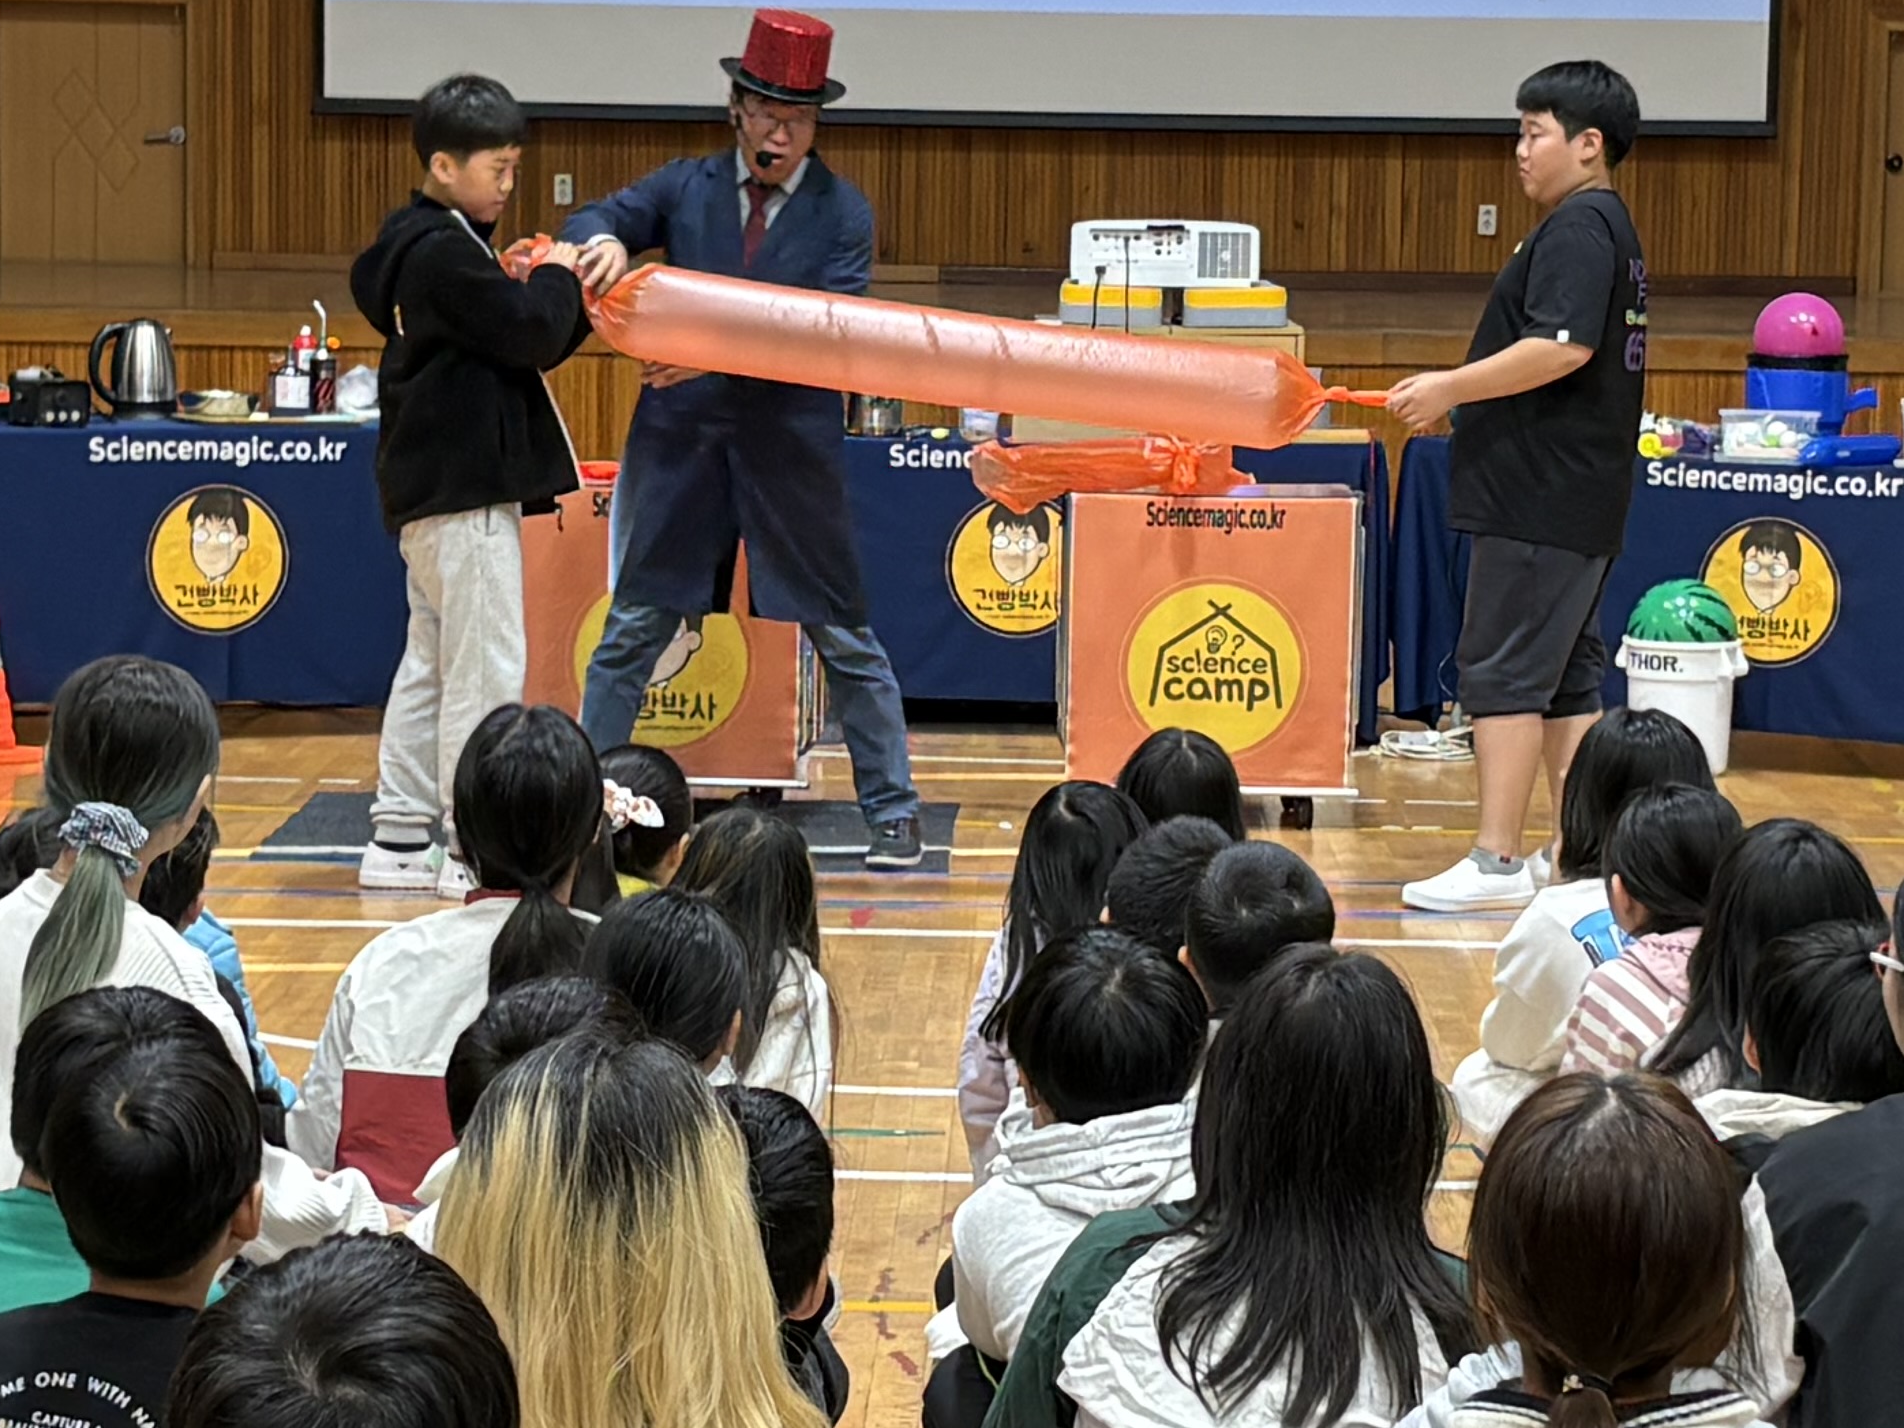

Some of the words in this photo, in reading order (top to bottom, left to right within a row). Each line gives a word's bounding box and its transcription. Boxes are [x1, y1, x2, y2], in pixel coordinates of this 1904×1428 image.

[88, 436, 347, 467] Sciencemagic.co.kr
[1647, 461, 1904, 500] Sciencemagic.co.kr
[1146, 501, 1285, 534] Sciencemagic.co.kr
[174, 583, 259, 608] 건빵박사
[1630, 652, 1684, 673] THOR.
[1163, 675, 1271, 712] camp
[34, 1372, 77, 1389] ONE
[87, 1376, 132, 1409] WITH
